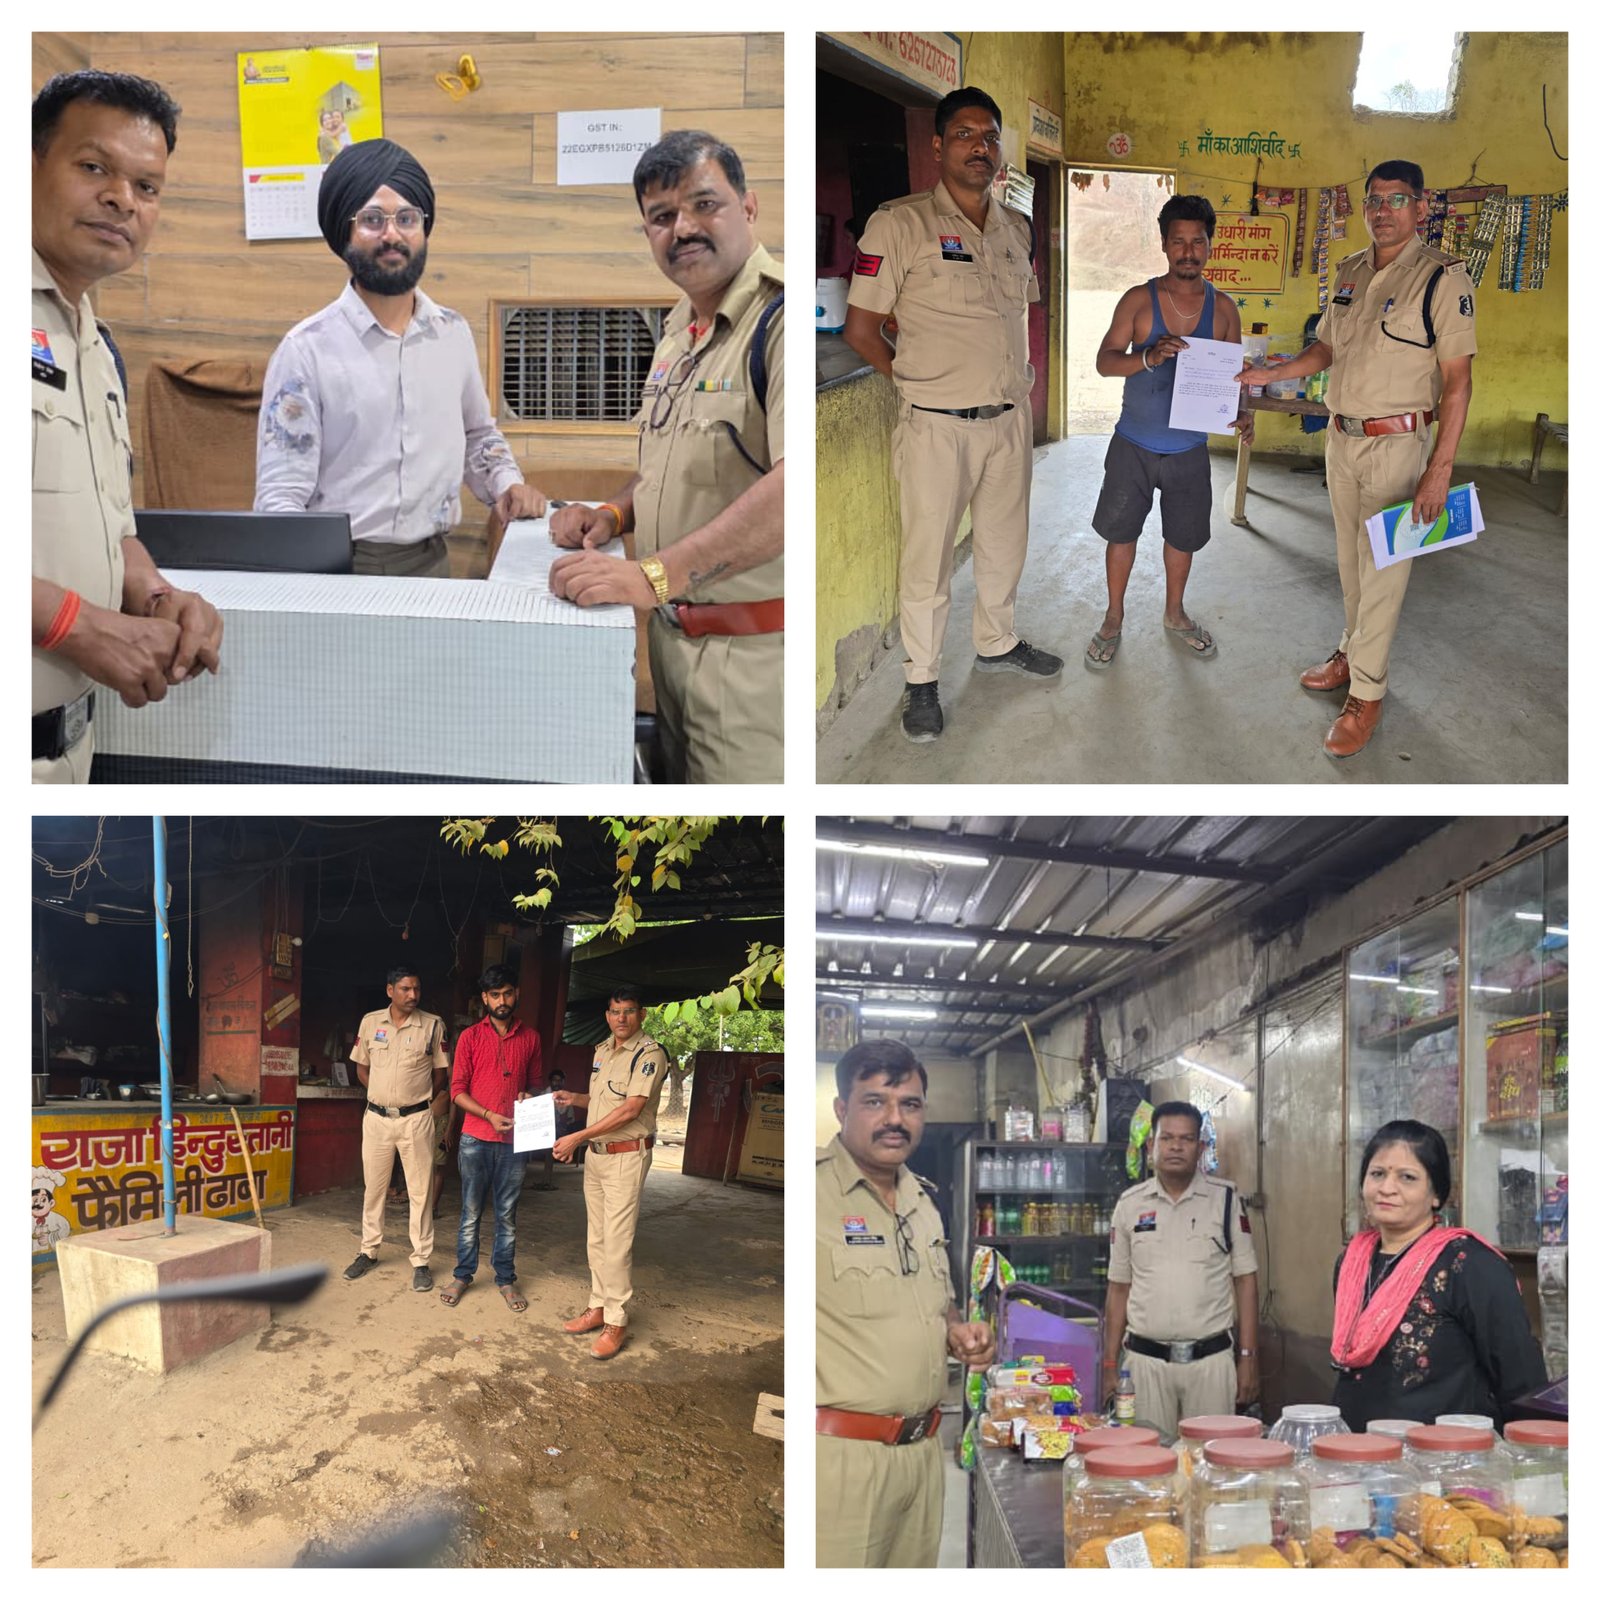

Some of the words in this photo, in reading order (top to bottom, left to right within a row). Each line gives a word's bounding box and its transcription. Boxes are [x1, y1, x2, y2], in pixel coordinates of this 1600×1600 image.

[899, 32, 956, 86] 6267273723
[587, 123, 607, 133] GST
[609, 123, 623, 132] IN:
[1197, 128, 1213, 156] माँ
[1213, 137, 1231, 155] का
[1216, 218, 1247, 242] उधारी
[1249, 248, 1260, 261] न
[1261, 243, 1279, 265] करें
[40, 1127, 148, 1172] राजा
[206, 1170, 268, 1210] ढाबा
